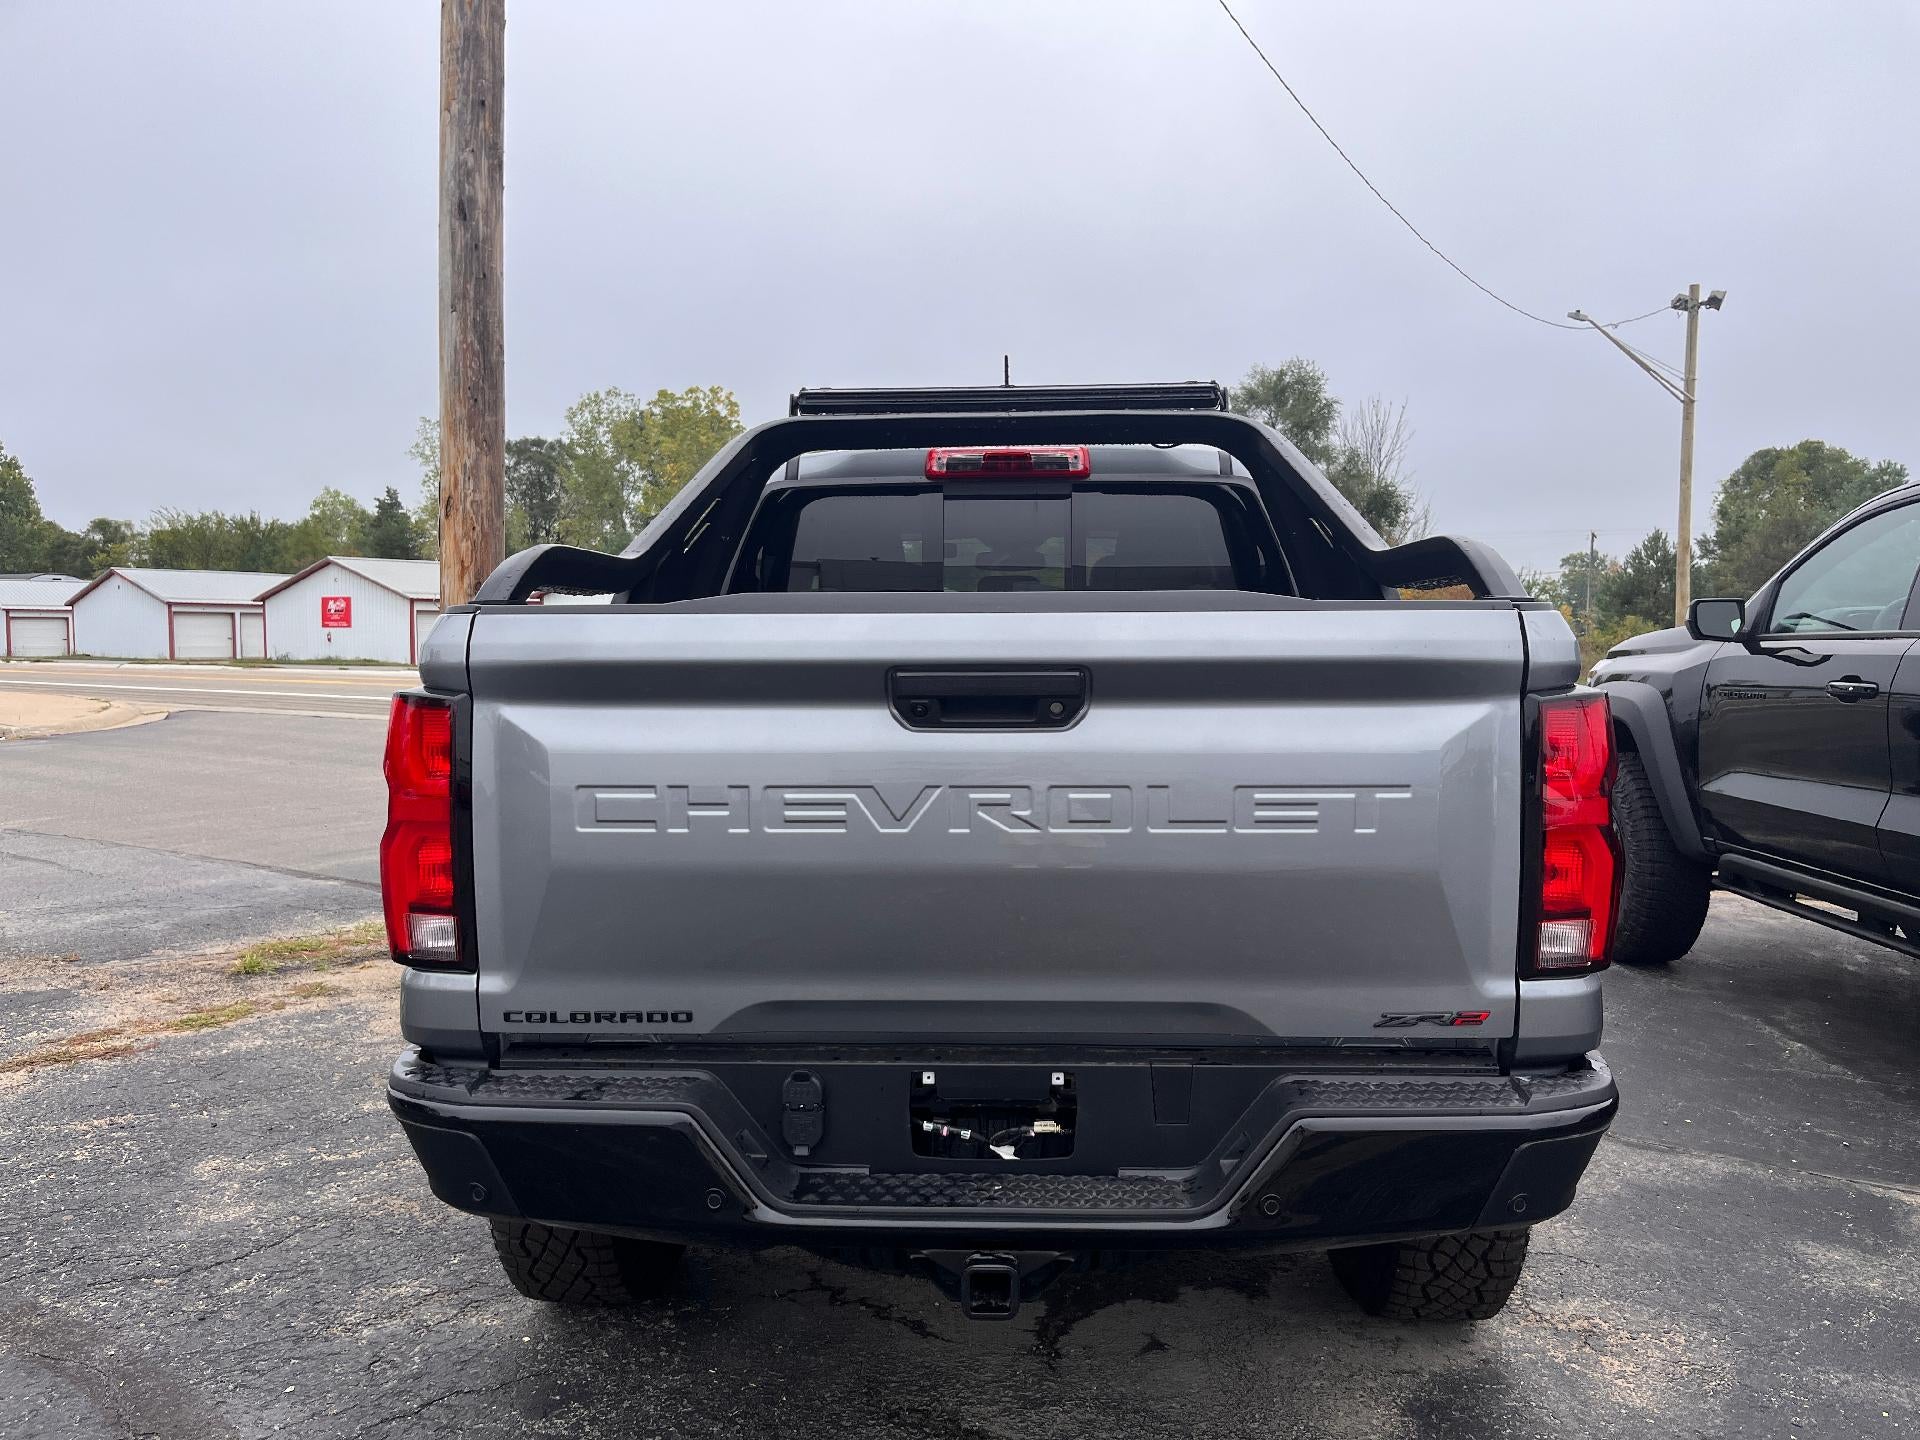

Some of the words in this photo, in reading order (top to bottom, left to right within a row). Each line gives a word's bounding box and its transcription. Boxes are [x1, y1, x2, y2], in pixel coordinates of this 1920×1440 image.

[575, 784, 1412, 833] CHEVROLET
[503, 1010, 694, 1024] COLORADO
[1373, 1010, 1491, 1028] ZR2
